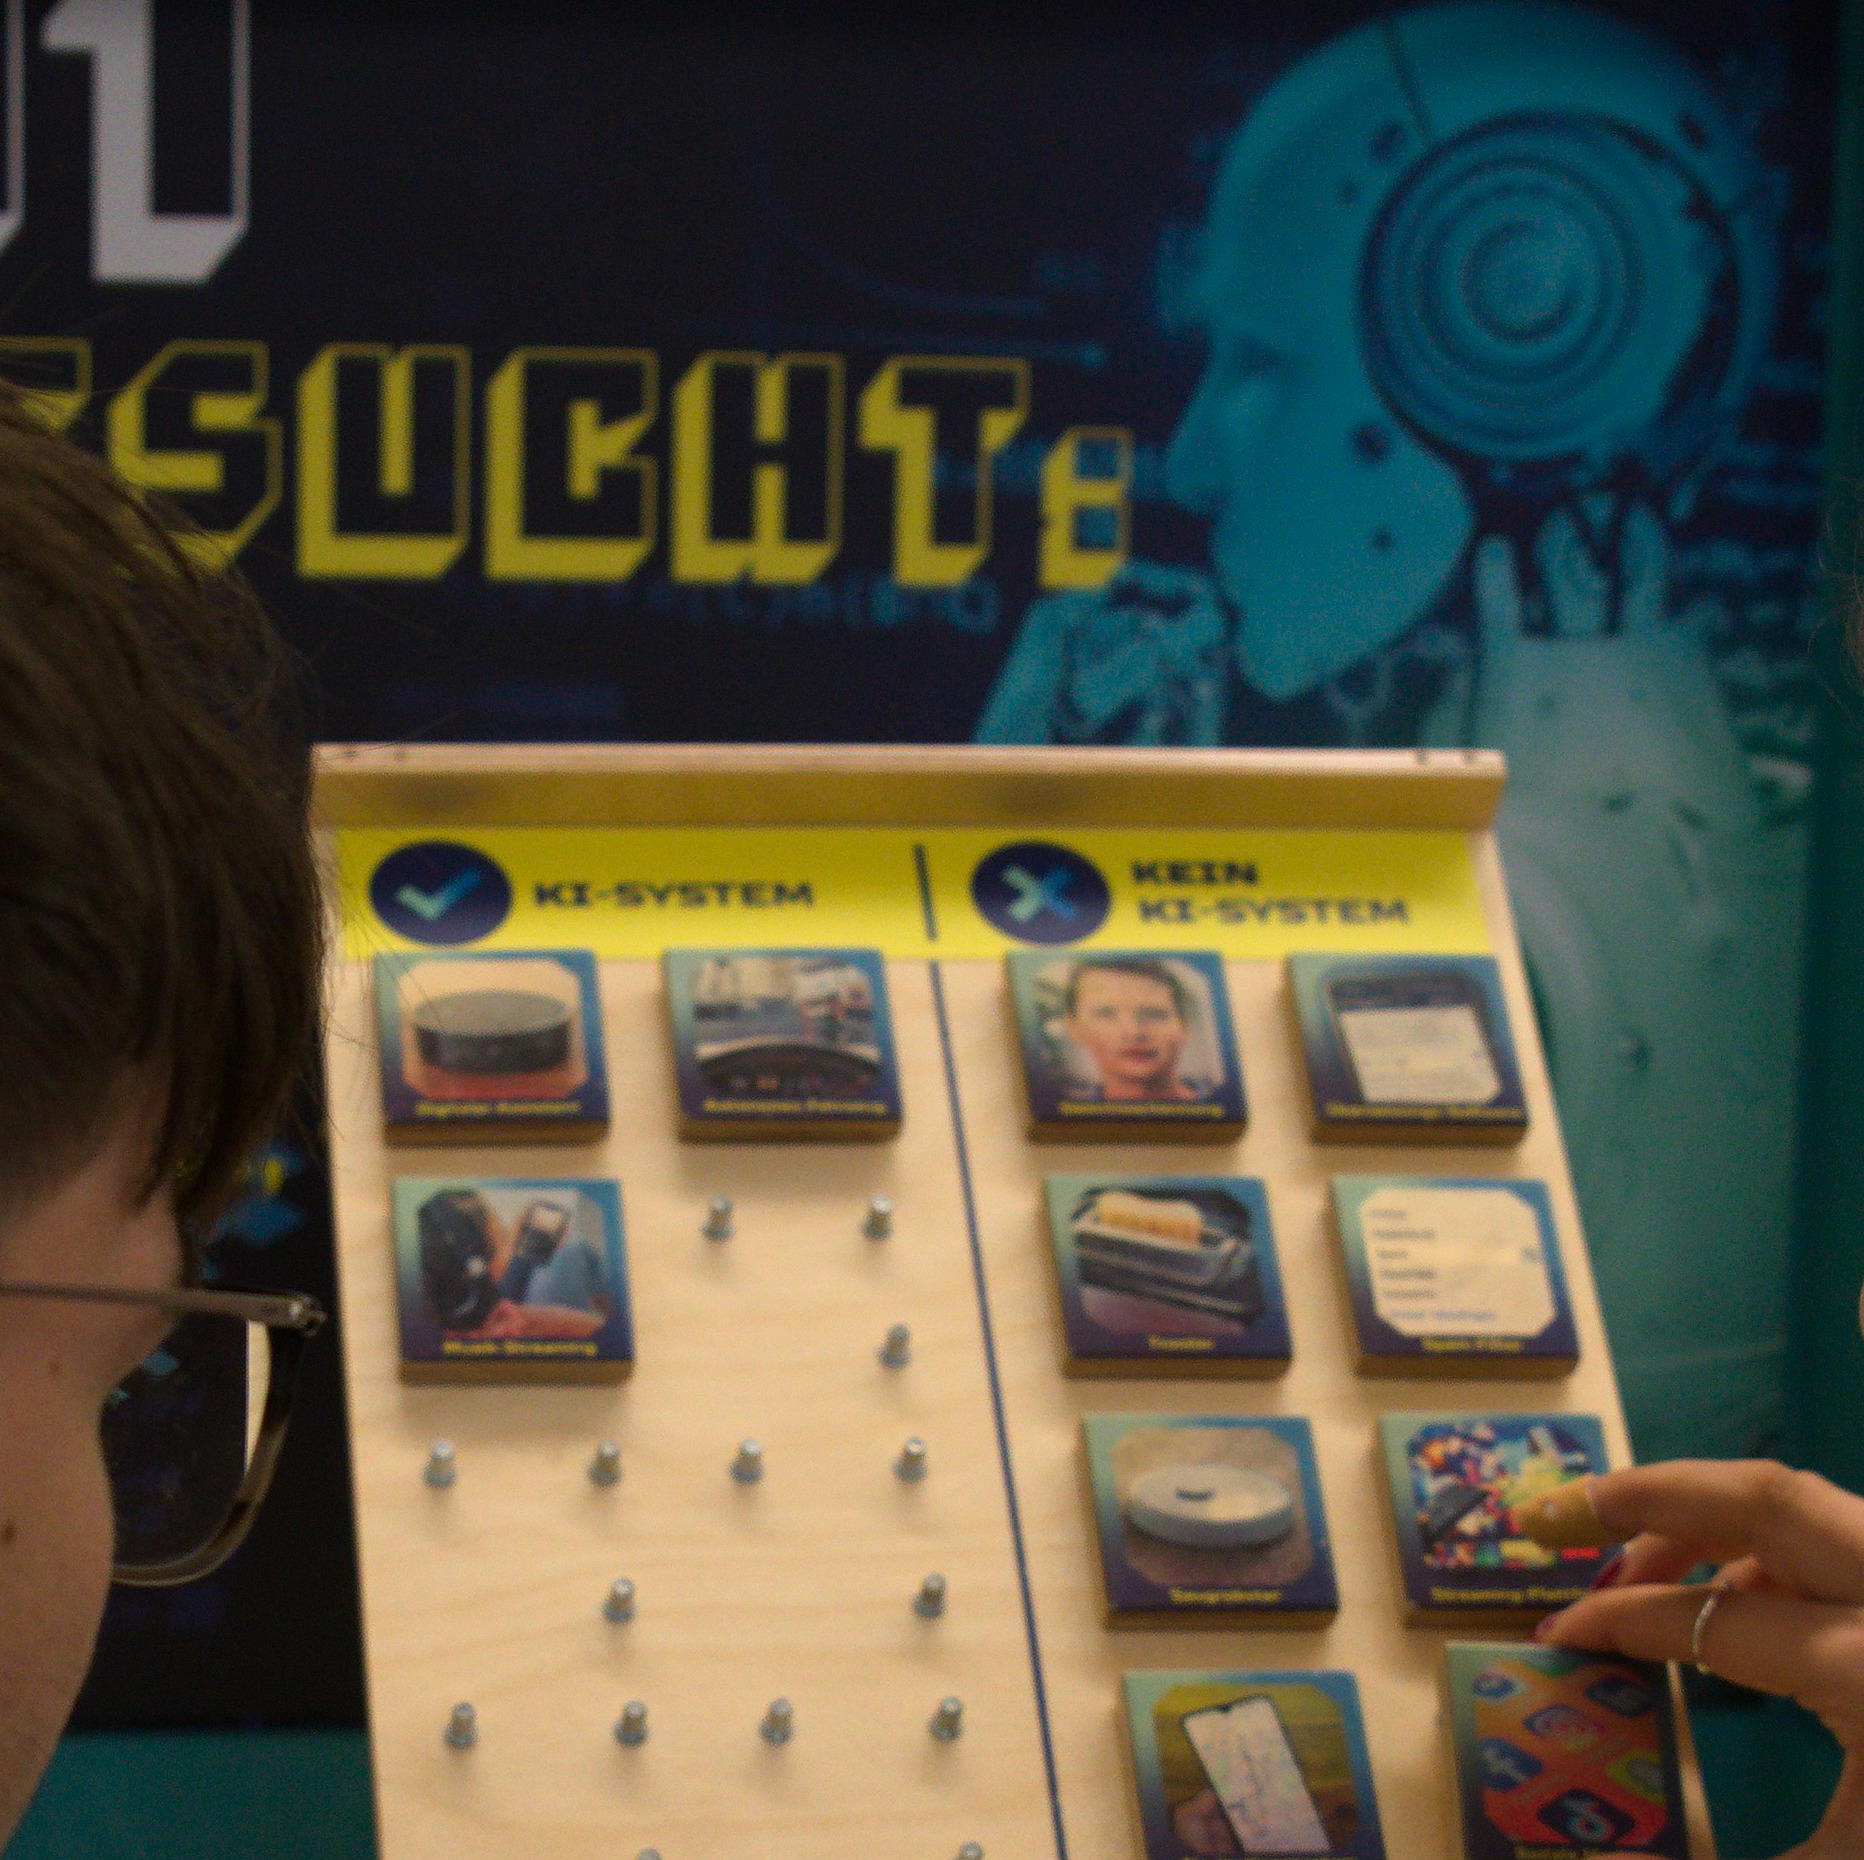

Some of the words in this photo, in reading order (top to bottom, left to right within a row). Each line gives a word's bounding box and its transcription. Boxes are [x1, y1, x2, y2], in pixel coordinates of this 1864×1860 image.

[1132, 860, 1258, 886] KEIN
[534, 880, 814, 908] KI-SYSTEM
[1138, 898, 1409, 925] KI-SYSTEM
